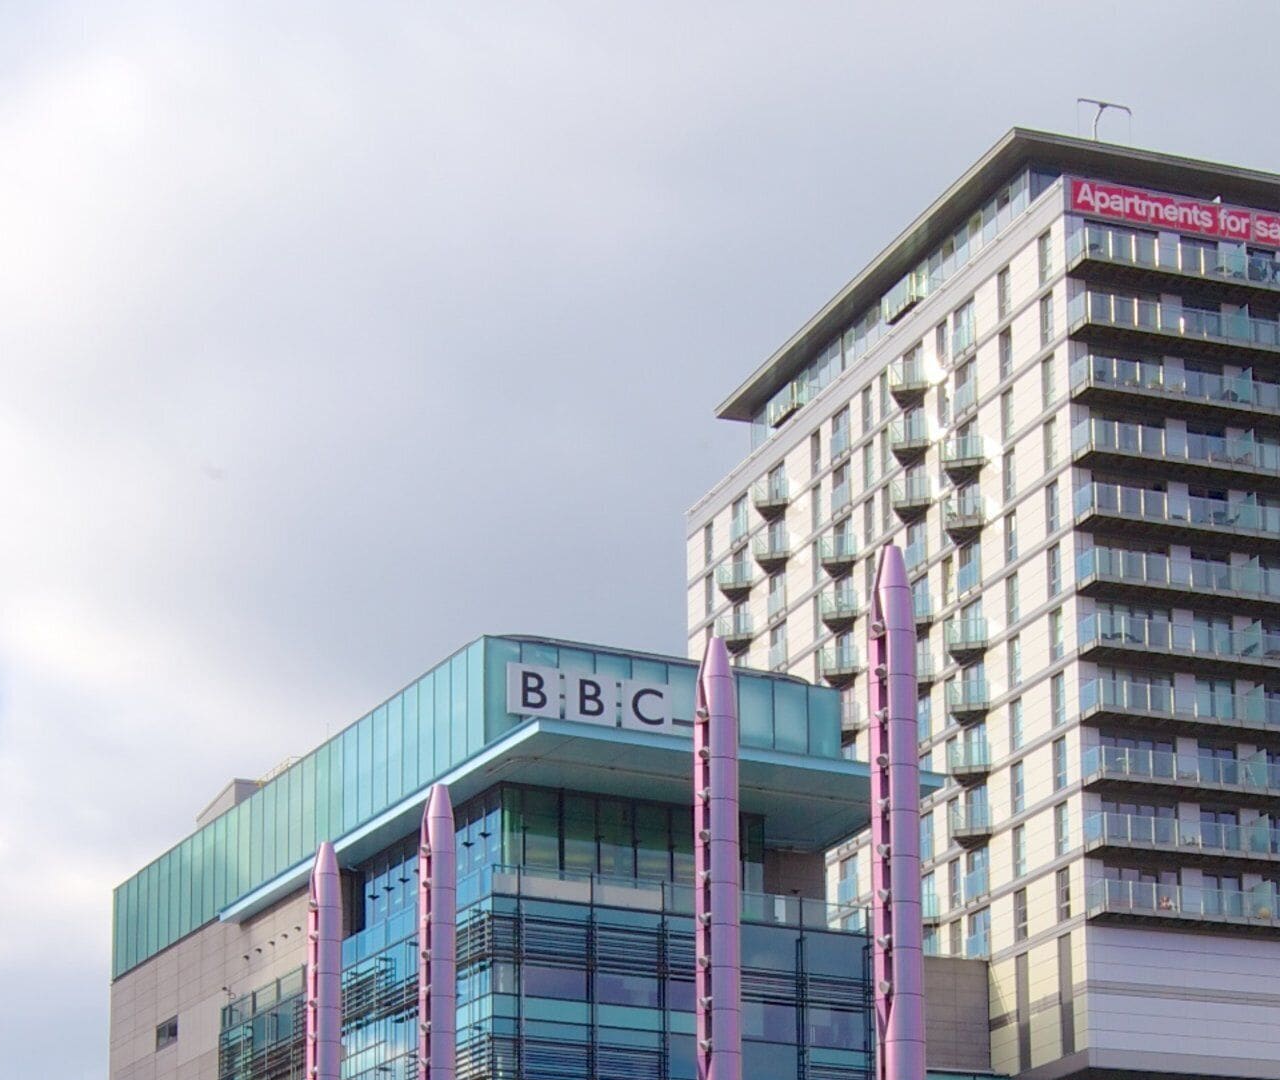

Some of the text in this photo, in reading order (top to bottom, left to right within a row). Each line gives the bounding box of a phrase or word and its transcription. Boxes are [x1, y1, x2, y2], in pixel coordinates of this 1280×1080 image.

[1077, 183, 1214, 228] Apartments
[1219, 208, 1250, 234] for
[521, 670, 665, 726] BBC
